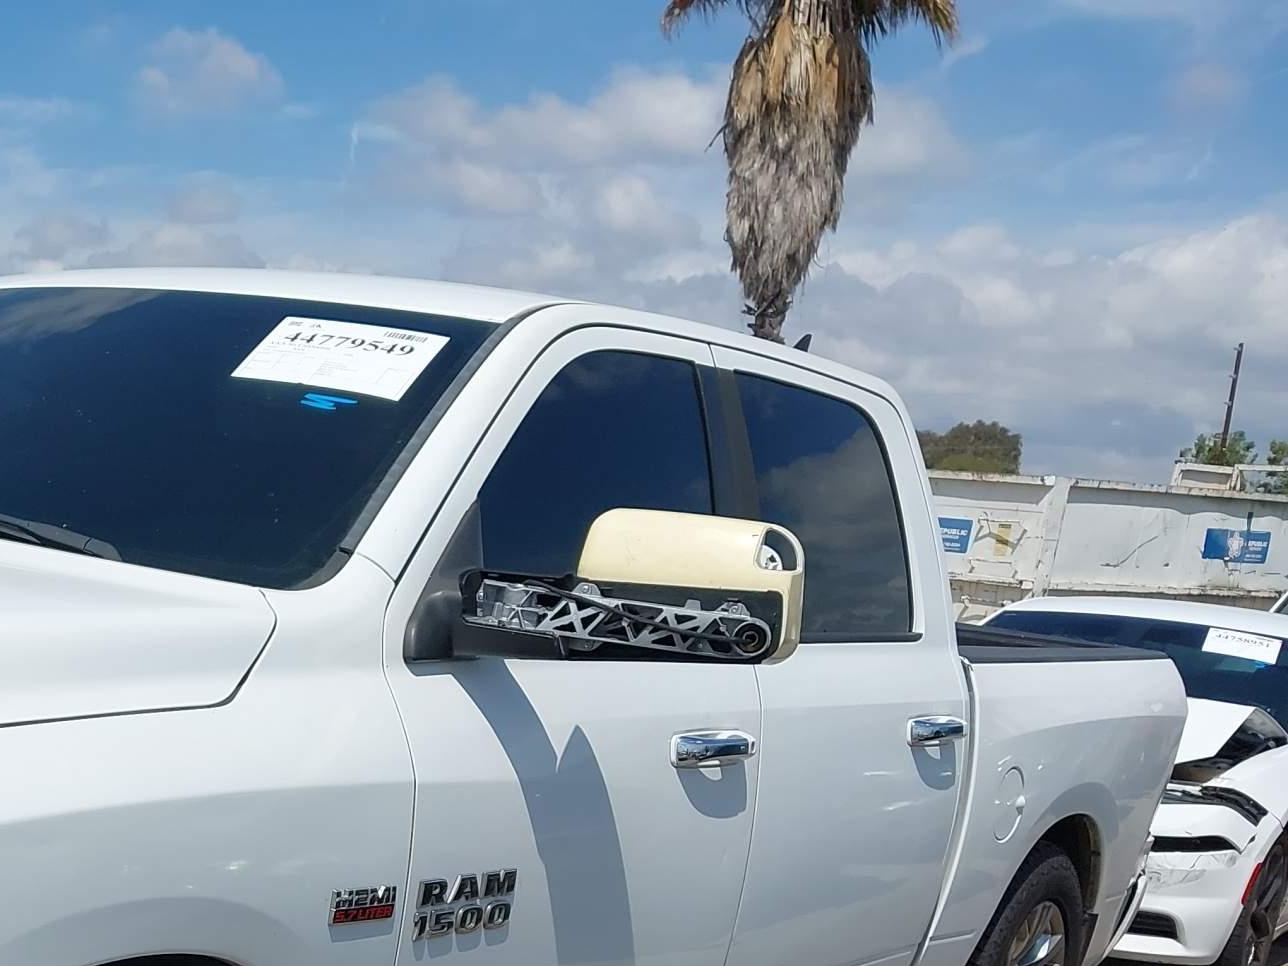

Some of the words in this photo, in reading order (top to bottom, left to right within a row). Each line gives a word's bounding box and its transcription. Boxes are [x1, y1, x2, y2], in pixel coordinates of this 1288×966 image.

[285, 332, 415, 357] 44779549
[331, 885, 397, 909] HEMI
[416, 868, 517, 908] RAM
[413, 900, 511, 941] 1500
